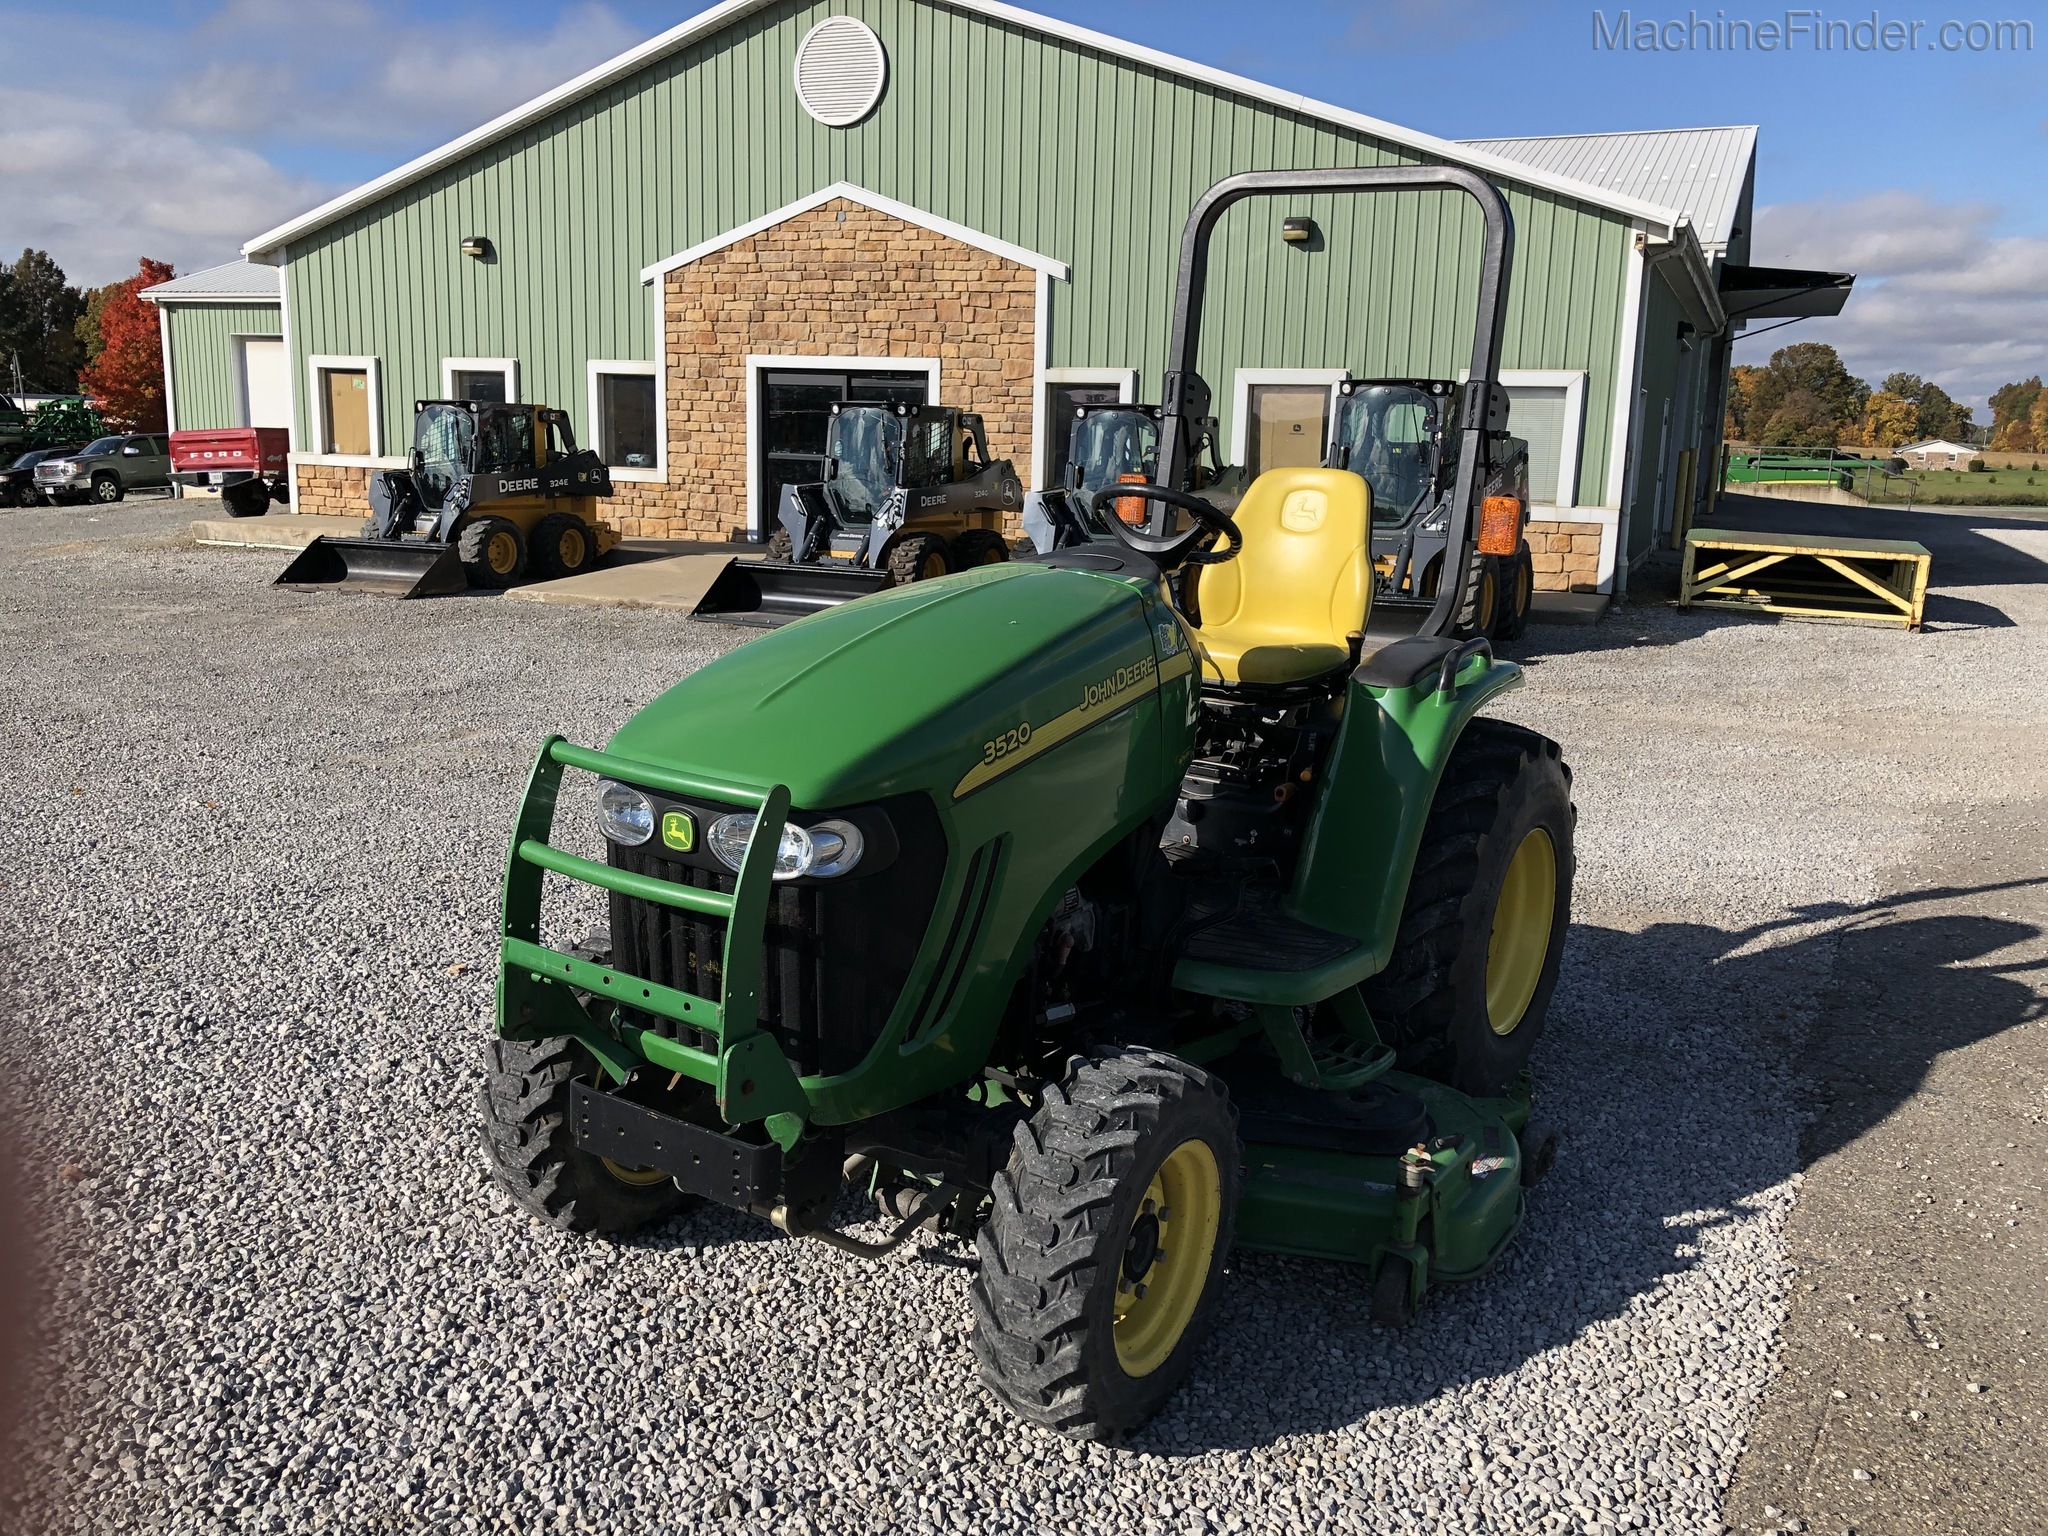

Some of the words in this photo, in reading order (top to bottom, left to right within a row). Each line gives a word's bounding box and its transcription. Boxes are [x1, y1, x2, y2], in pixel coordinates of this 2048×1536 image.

[190, 451, 242, 459] FORD
[499, 478, 538, 493] DEERE
[920, 494, 947, 507] DEERE
[1080, 676, 1117, 710] JOHN
[1116, 655, 1155, 691] DEERE
[983, 722, 1031, 765] 3520
